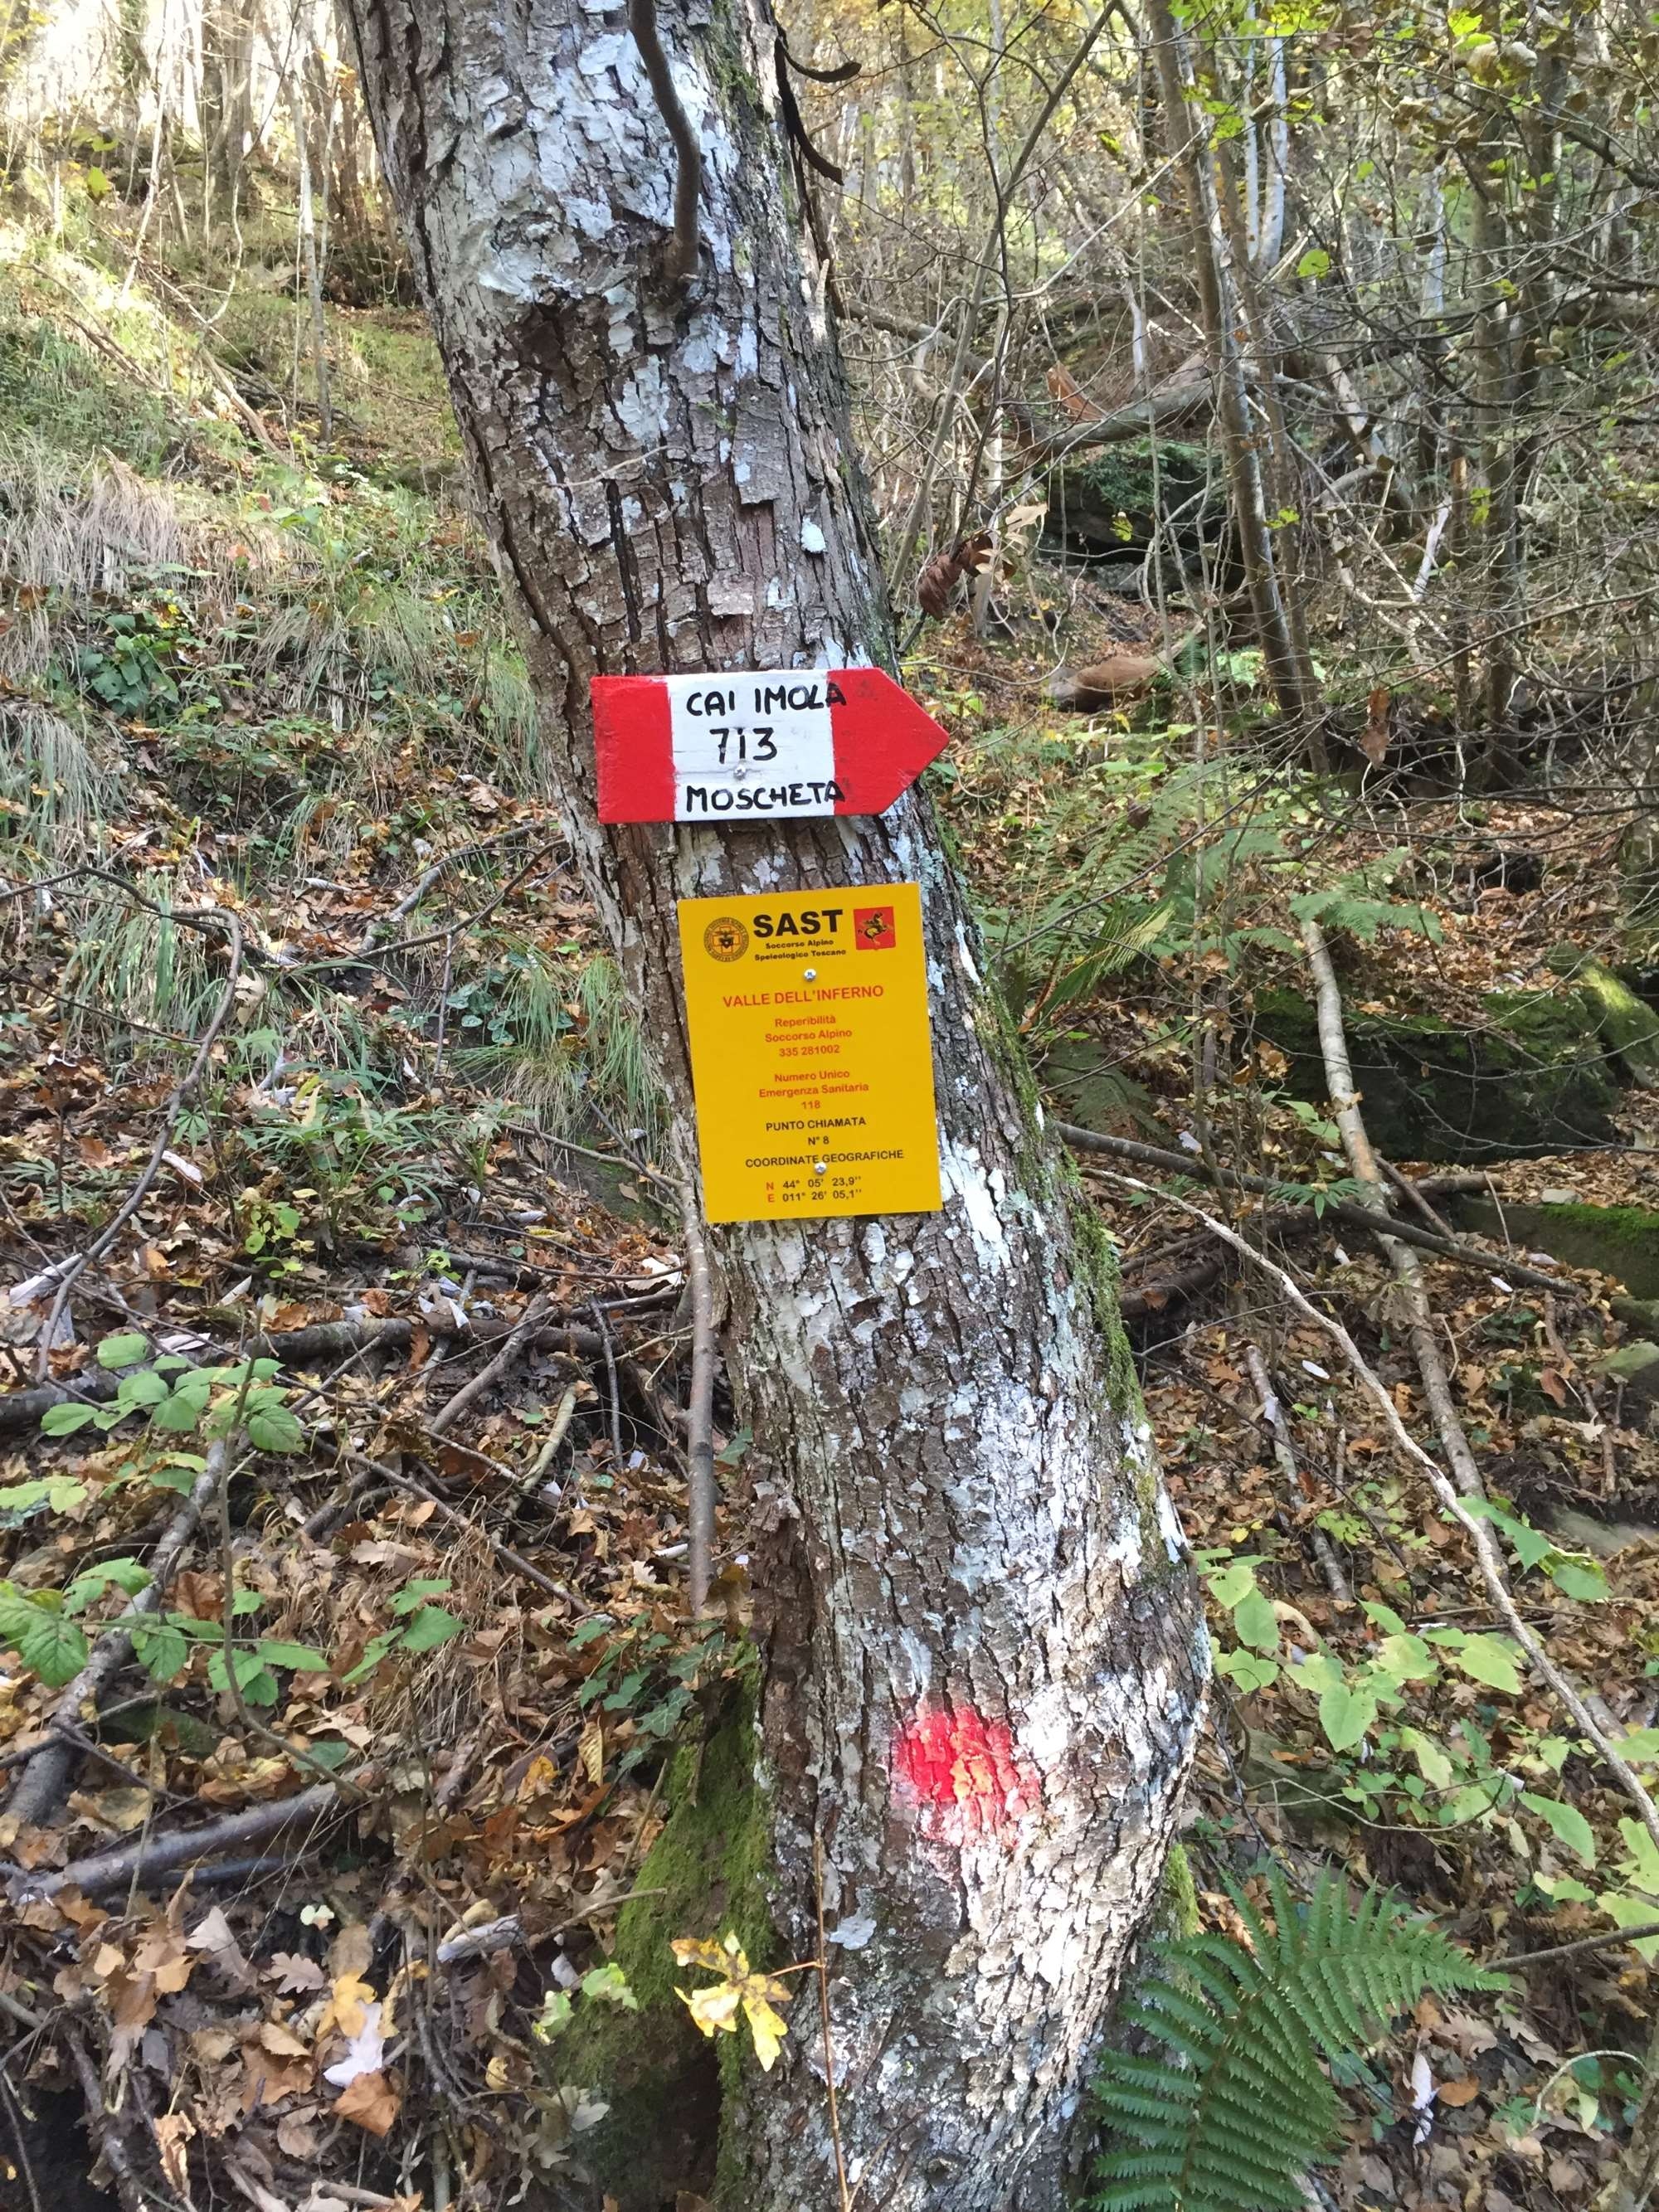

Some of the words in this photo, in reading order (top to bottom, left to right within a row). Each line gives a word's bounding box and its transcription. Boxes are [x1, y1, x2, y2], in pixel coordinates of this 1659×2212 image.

[686, 690, 736, 717] CAI
[755, 683, 847, 715] IMOLA
[709, 727, 778, 764] 713
[686, 780, 845, 813] MOSCHETA
[753, 909, 844, 938] SAST
[766, 941, 805, 950] Soccorso
[808, 938, 834, 948] Alpino
[754, 950, 809, 962] Speleologico
[810, 949, 847, 958] Toscano
[723, 994, 771, 1008] VALLE
[775, 985, 884, 1004] DELL'INFERNO
[775, 1015, 836, 1028] Reperibilità
[765, 1032, 815, 1043] Soccorso
[818, 1028, 853, 1040] Alpino
[779, 1047, 798, 1057] 335
[801, 1044, 840, 1056] 281002
[774, 1072, 816, 1082] Numero
[819, 1069, 850, 1080] Unico
[759, 1087, 819, 1099] Emergenza
[821, 1082, 869, 1094] Sanitaria
[801, 1100, 820, 1110] 118
[766, 1121, 805, 1131] PUNTO
[807, 1116, 867, 1130] CHIAMATA
[808, 1136, 820, 1145] N°
[823, 1135, 830, 1145] 8
[746, 1155, 819, 1168] COORDINATE
[822, 1150, 904, 1163] GEOGRAFICHE
[766, 1181, 774, 1190] N
[767, 1194, 775, 1203] E
